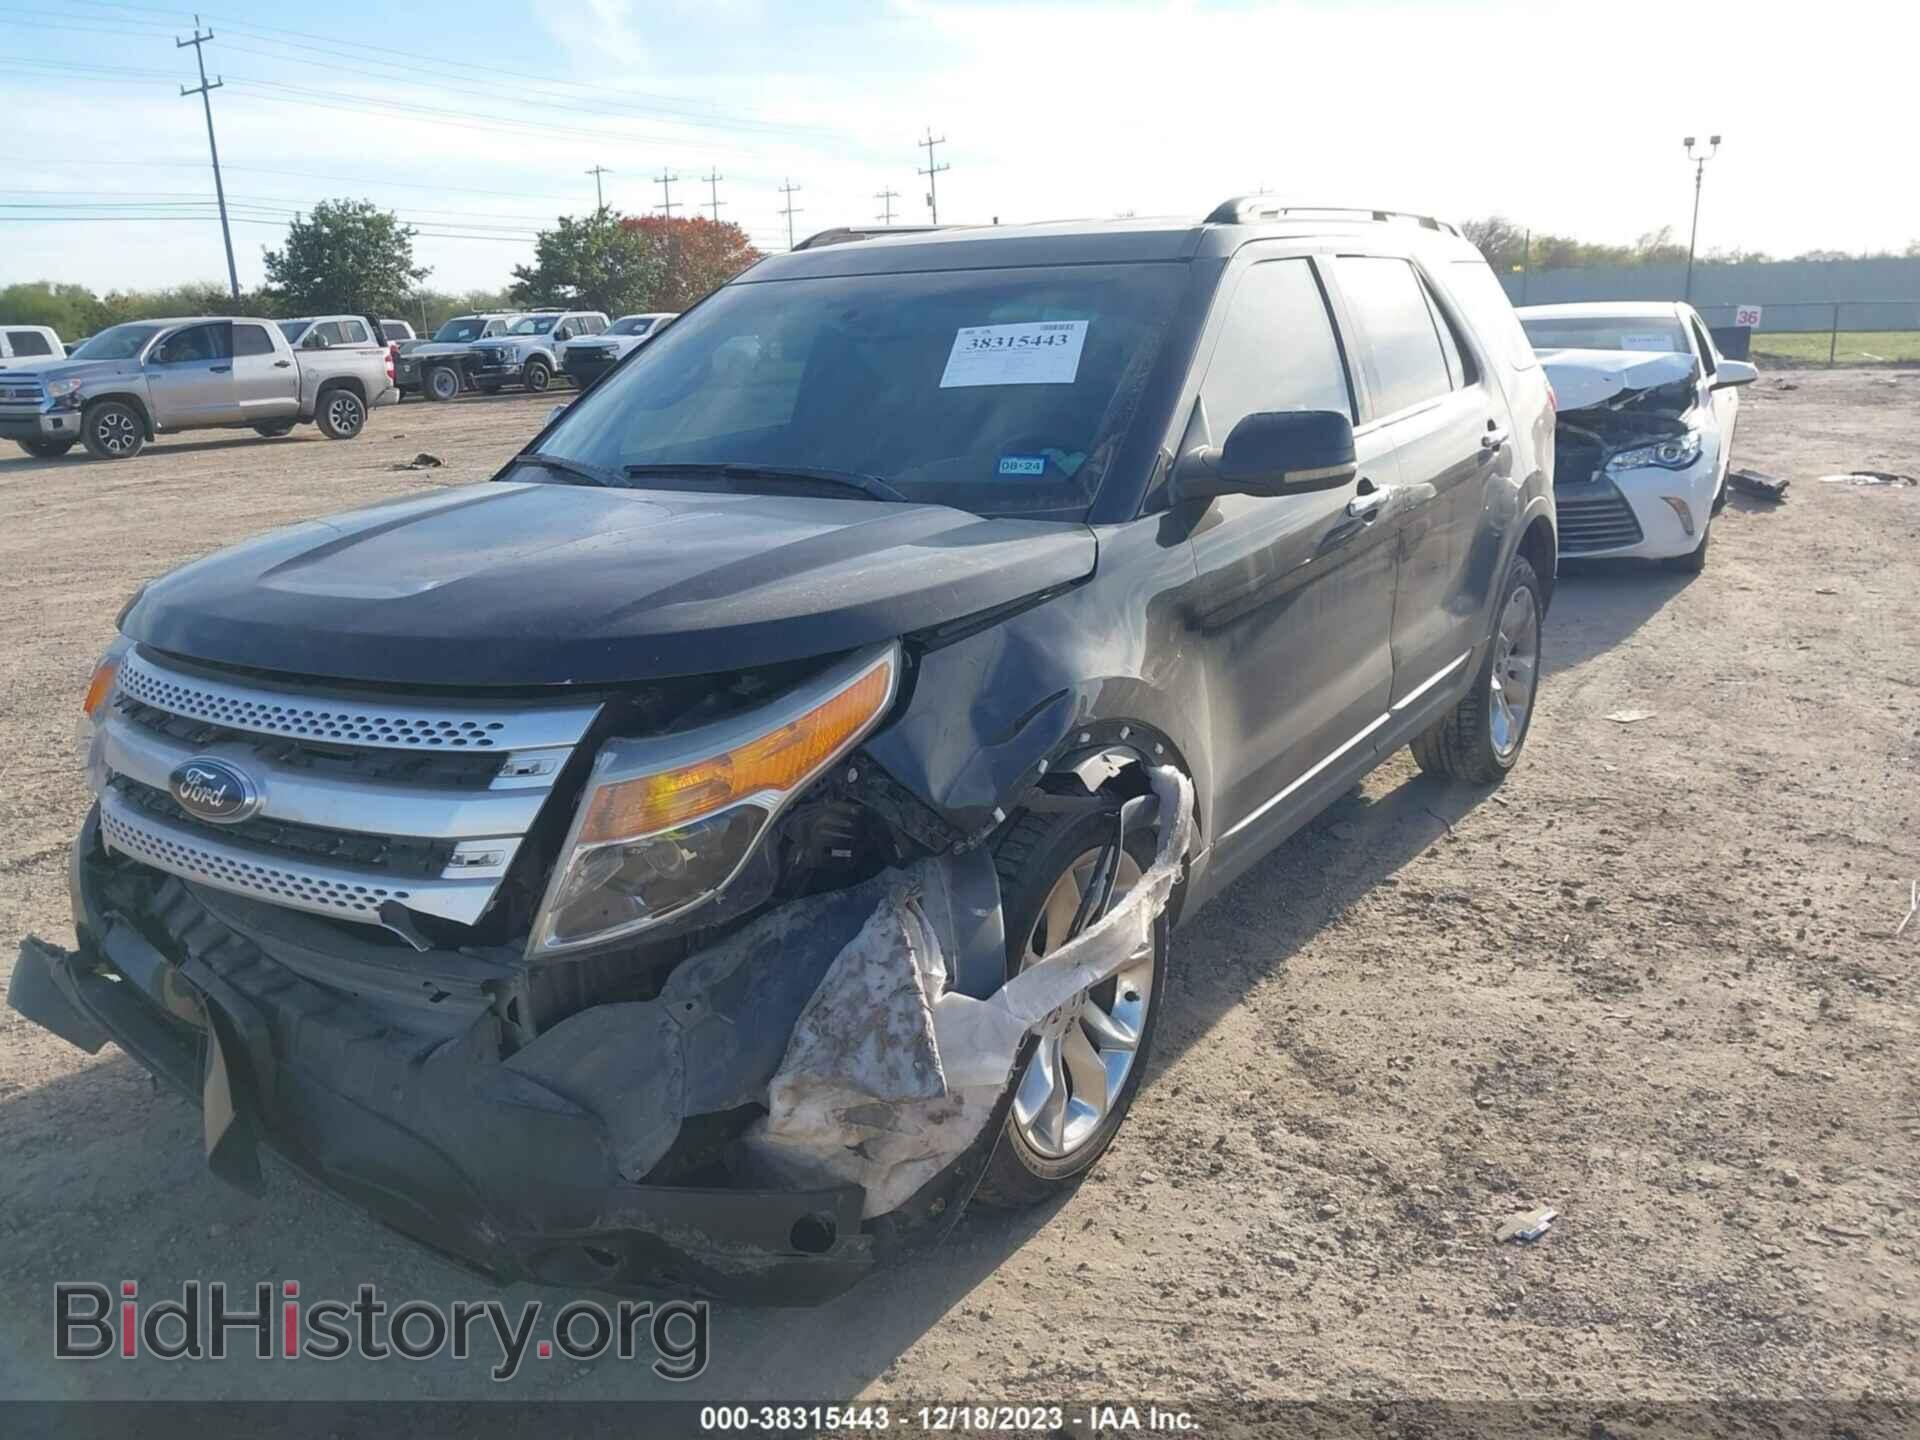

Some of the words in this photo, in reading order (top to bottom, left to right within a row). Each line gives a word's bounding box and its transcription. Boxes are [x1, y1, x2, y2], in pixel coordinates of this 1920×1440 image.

[1738, 310, 1758, 324] 36
[966, 334, 1068, 350] 38315443
[180, 768, 226, 806] Ford
